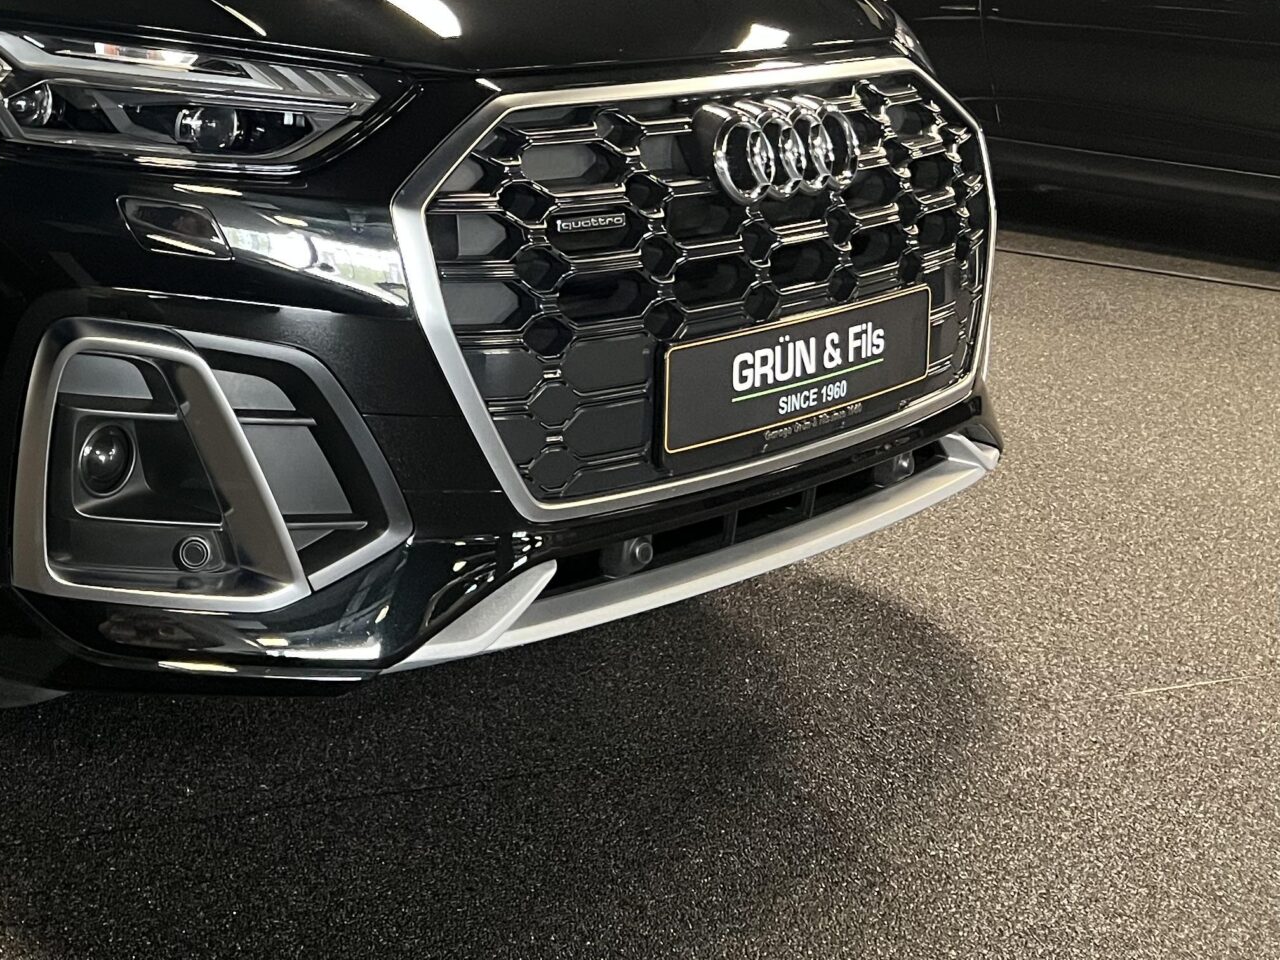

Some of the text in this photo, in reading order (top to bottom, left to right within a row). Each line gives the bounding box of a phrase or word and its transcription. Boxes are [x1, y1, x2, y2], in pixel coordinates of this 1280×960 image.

[561, 217, 623, 230] quattro
[732, 322, 885, 392] GRÜN & Fils
[778, 388, 818, 415] SINCE
[820, 380, 847, 404] 1960
